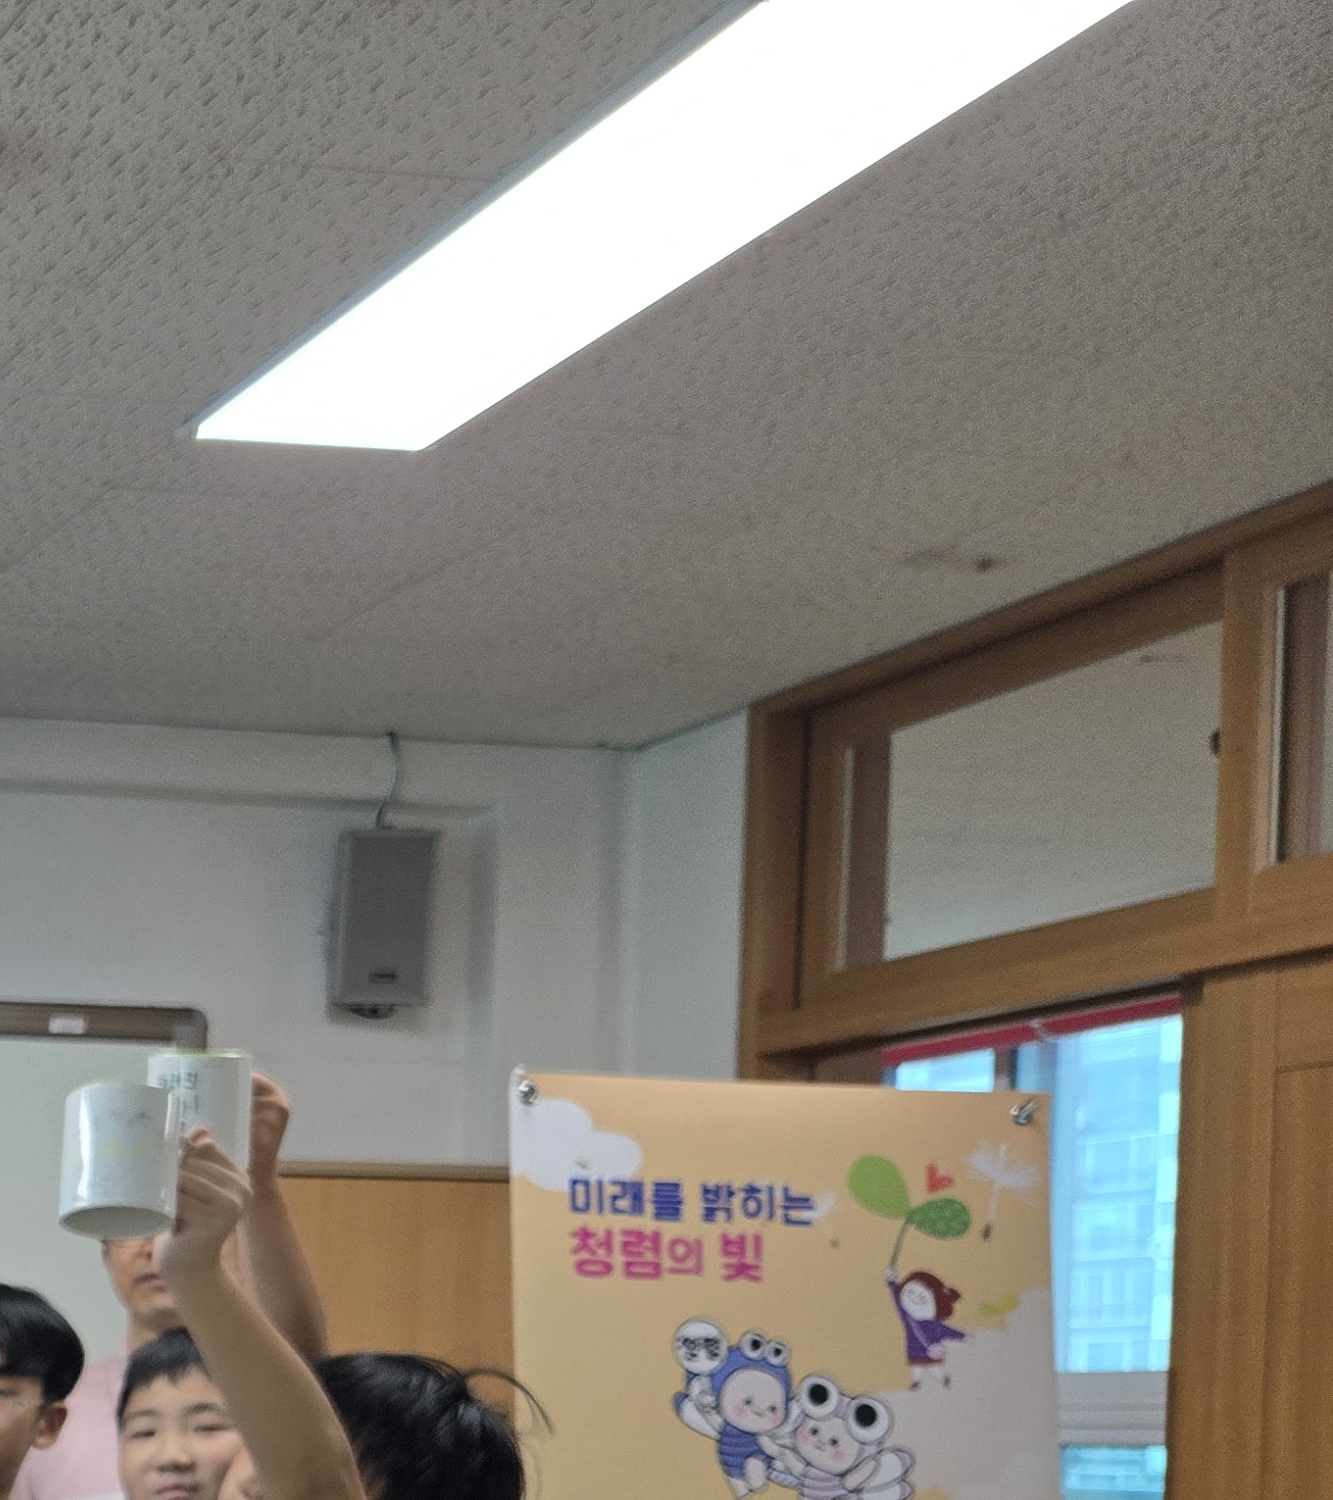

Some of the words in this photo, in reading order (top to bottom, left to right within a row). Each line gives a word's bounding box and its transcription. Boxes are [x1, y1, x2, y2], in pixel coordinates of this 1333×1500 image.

[569, 1178, 683, 1223] 미래를
[700, 1182, 816, 1227] 밝히는
[569, 1226, 704, 1280] 청렴의
[720, 1232, 764, 1283] 빛
